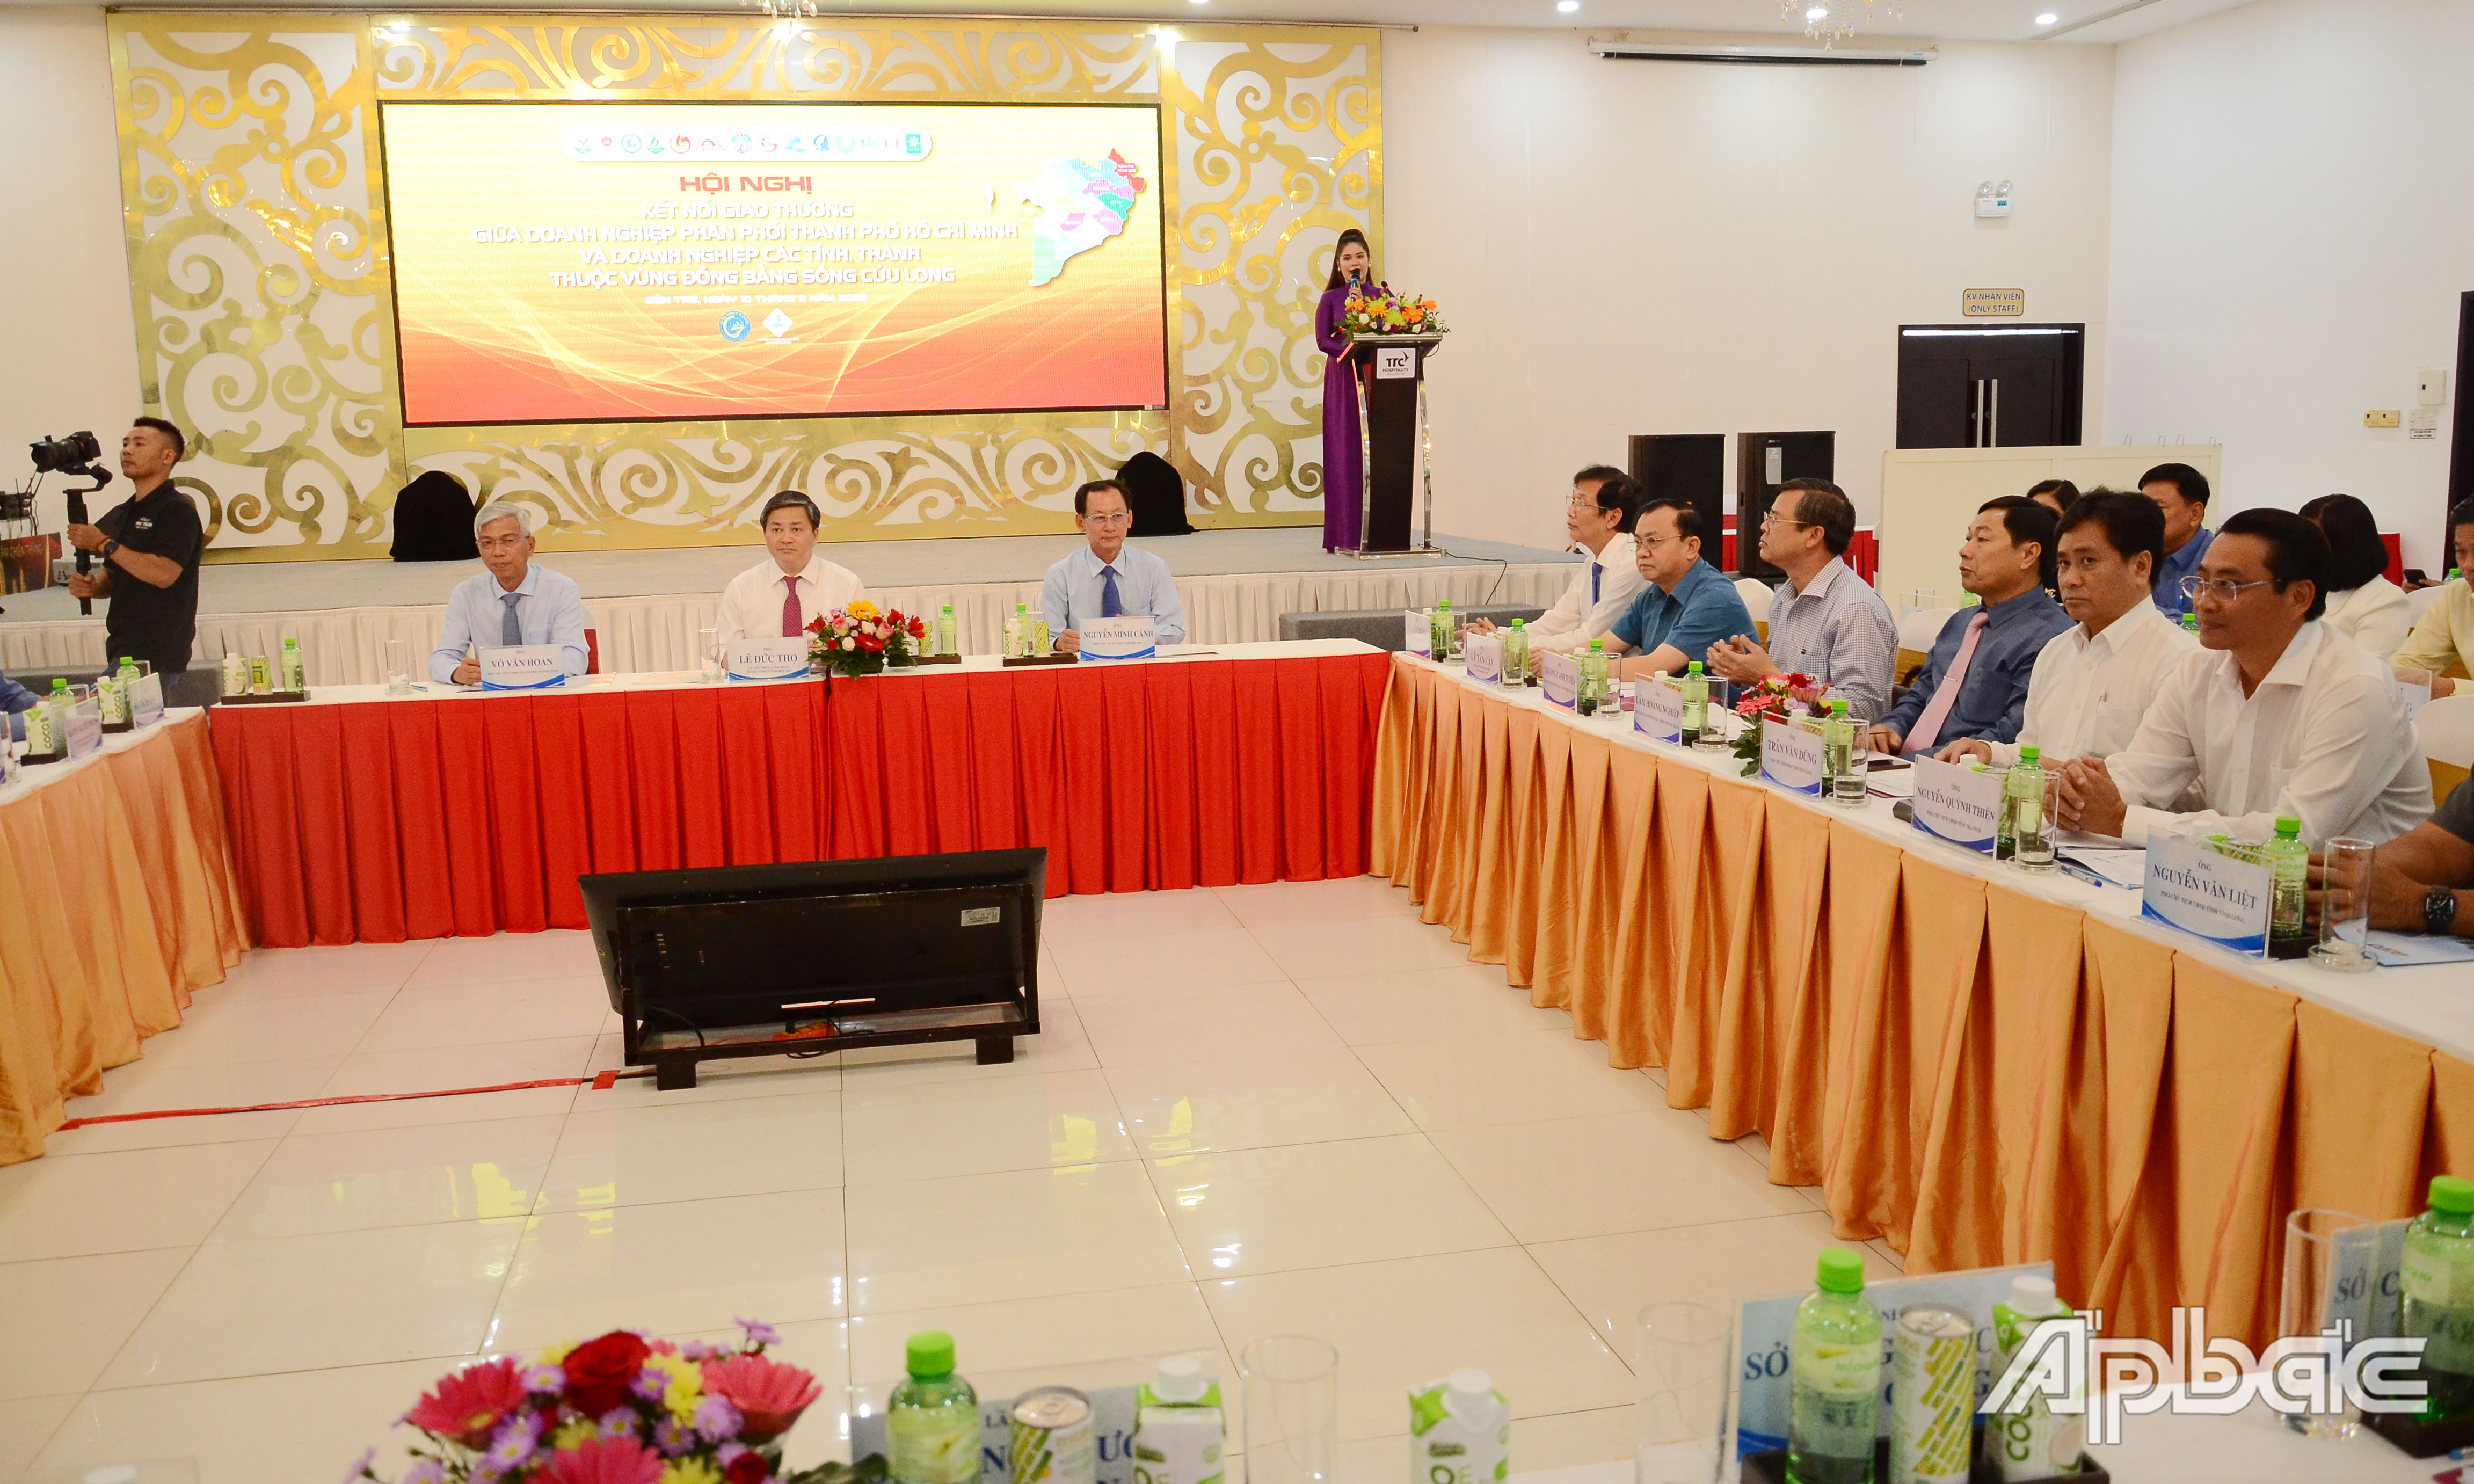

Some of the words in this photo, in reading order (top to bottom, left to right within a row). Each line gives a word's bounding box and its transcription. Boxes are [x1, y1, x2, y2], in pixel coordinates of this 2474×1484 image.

[680, 173, 729, 194] HỘI
[740, 177, 812, 194] NGHỊ
[642, 199, 679, 218] KẾT
[682, 200, 717, 218] NỐI
[721, 202, 769, 218] GIAO
[773, 201, 854, 217] THƯƠNG
[472, 223, 522, 242] GIỮA
[526, 226, 597, 242] DOANH
[601, 223, 675, 244] NGHIỆP
[680, 222, 735, 240] PHÂN
[739, 221, 786, 239] PHỐI
[789, 222, 855, 239] THÀNH
[861, 219, 900, 239] PHỐ
[904, 219, 931, 239] HỒ
[934, 221, 965, 238] CHÍ
[969, 223, 1018, 238] MINH
[579, 245, 608, 264] VÀ
[612, 248, 681, 263] DOANH
[687, 245, 759, 265] NGHIỆP
[763, 243, 801, 262] CÁC
[805, 243, 853, 263] TỈNH,
[855, 243, 921, 261] THÀNH
[550, 268, 618, 290] THUỘC
[620, 267, 678, 286] VÙNG
[681, 265, 738, 285] ĐỒNG
[743, 263, 797, 285] BẰNG
[802, 266, 857, 284] SÔNG
[861, 264, 900, 283] CỬU
[904, 268, 955, 282] LONG
[2003, 292, 2020, 300] VIÊN
[1386, 358, 1405, 367] TTC
[1083, 628, 1112, 638] NGUYỄN
[1134, 628, 1153, 637] CẢNH
[491, 659, 504, 667] VÕ
[506, 658, 525, 667] VĂN
[527, 658, 553, 666] HOAN
[739, 653, 752, 663] LÊ
[755, 653, 774, 663] ĐỨC
[777, 654, 797, 664] THỌ
[1785, 745, 1798, 758] VĂN
[1799, 749, 1816, 765] DŨNG
[1917, 787, 1944, 803] NGUYỄN
[1946, 797, 1970, 813] QUỲNH
[1973, 805, 1995, 822] THIỆN
[2198, 860, 2211, 871] ÔNG
[2153, 864, 2199, 890] NGUYỄN
[2203, 881, 2226, 899] VĂN
[2230, 889, 2258, 910] LIỆT
[1745, 1341, 1789, 1380] SỞ
